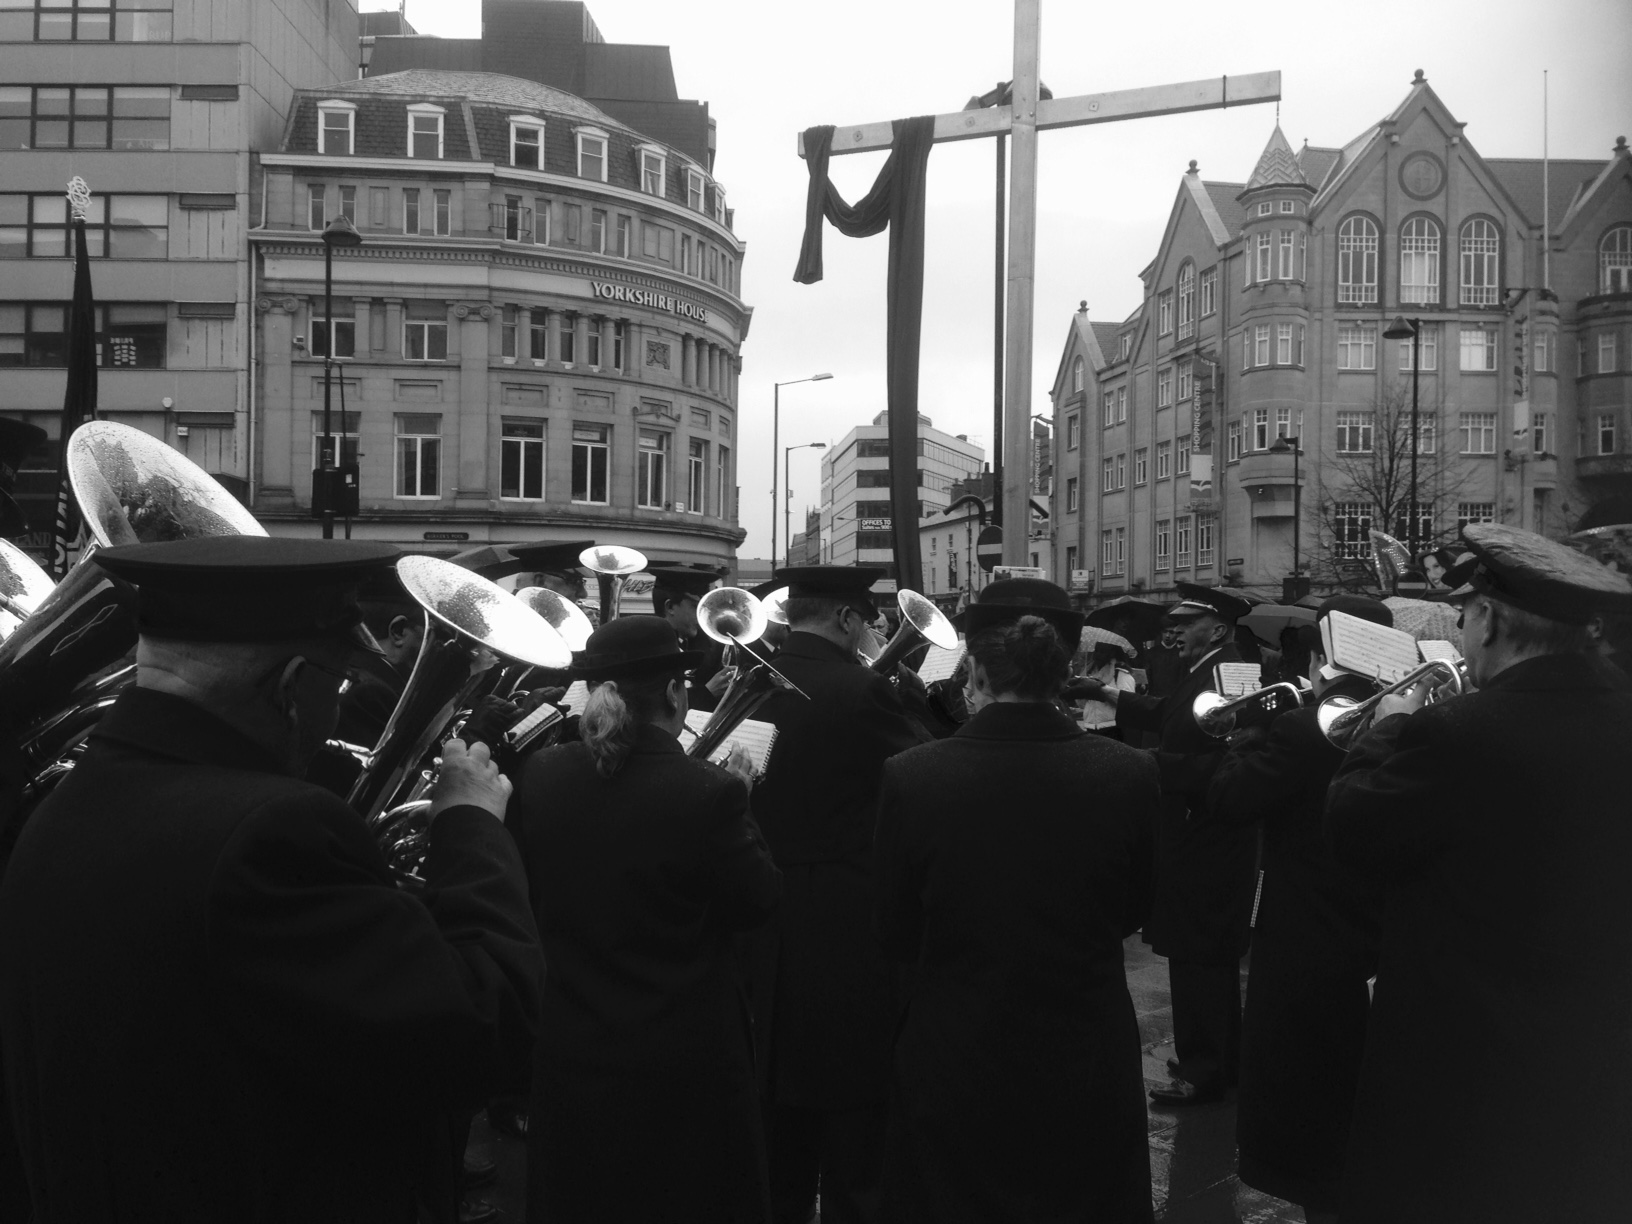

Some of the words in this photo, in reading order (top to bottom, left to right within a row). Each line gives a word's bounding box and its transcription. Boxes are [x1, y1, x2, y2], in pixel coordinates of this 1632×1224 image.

[592, 281, 673, 311] YORKSHIRE
[675, 300, 709, 323] HOUSE
[1193, 380, 1201, 412] CENTRE
[1193, 413, 1201, 453] SHOPPING
